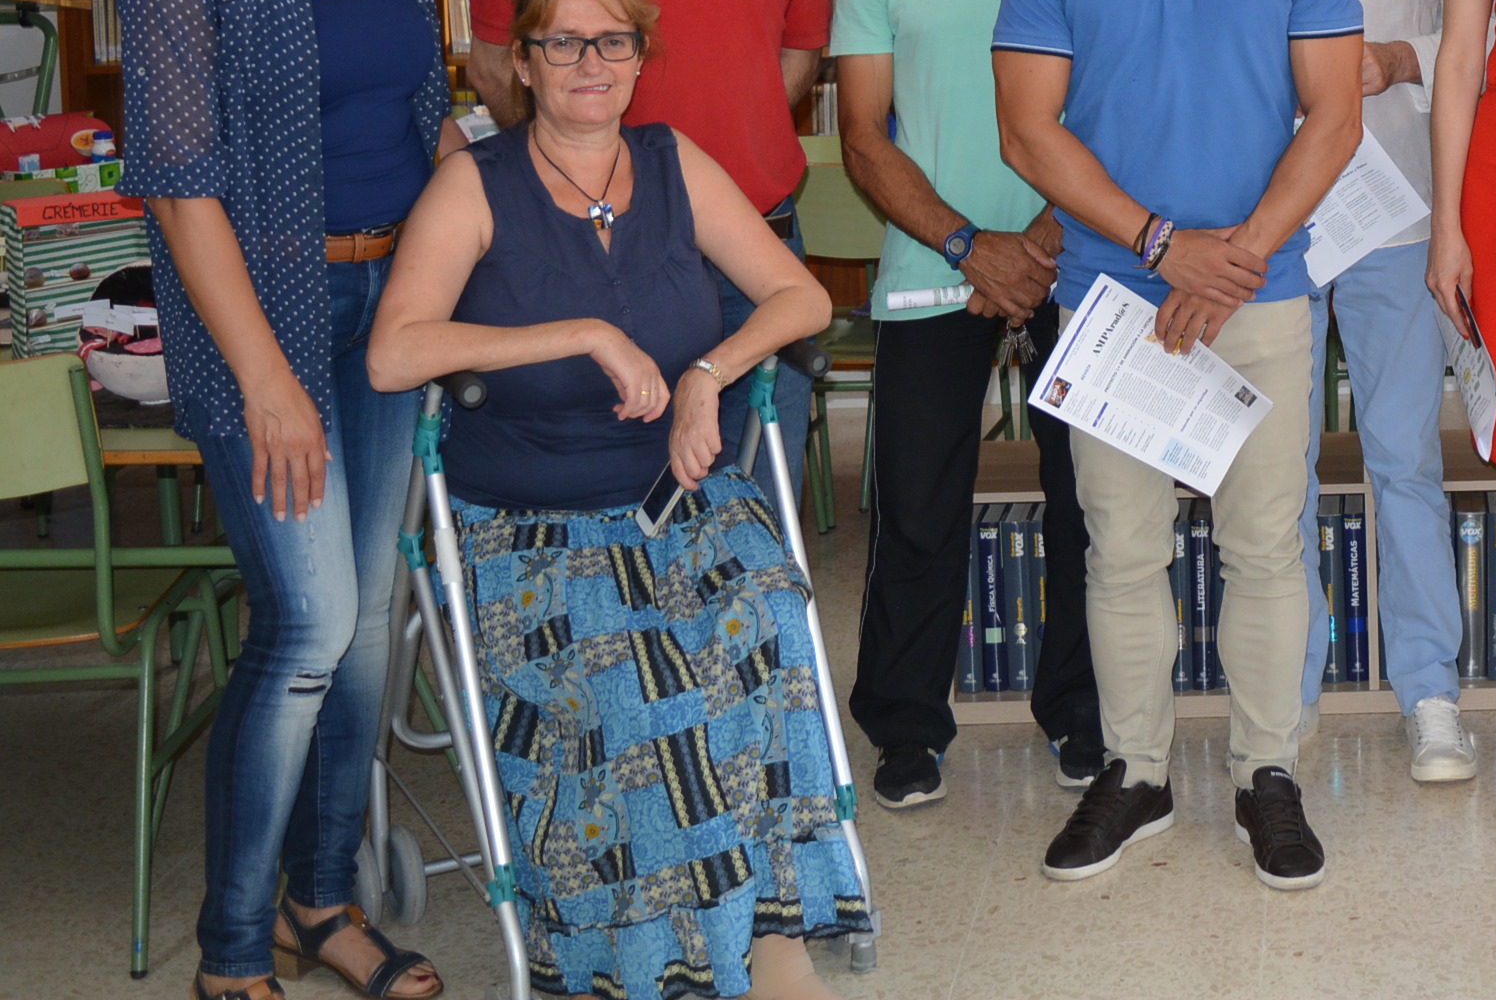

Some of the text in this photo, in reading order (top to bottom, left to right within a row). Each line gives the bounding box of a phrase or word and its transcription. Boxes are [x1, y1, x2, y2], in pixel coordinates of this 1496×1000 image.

[42, 202, 120, 220] CRÉMERIE
[980, 531, 998, 540] VOX
[1191, 530, 1209, 538] VOX
[1325, 526, 1334, 550] VOX
[1344, 522, 1362, 530] VOX
[1460, 527, 1482, 536] VOX
[1014, 532, 1024, 557] VOX
[1176, 533, 1184, 558] VOX
[1197, 554, 1205, 610] LITERATURA
[1349, 540, 1359, 607] MATEMÁTICAS
[1468, 548, 1478, 609] MULTIMEDIA
